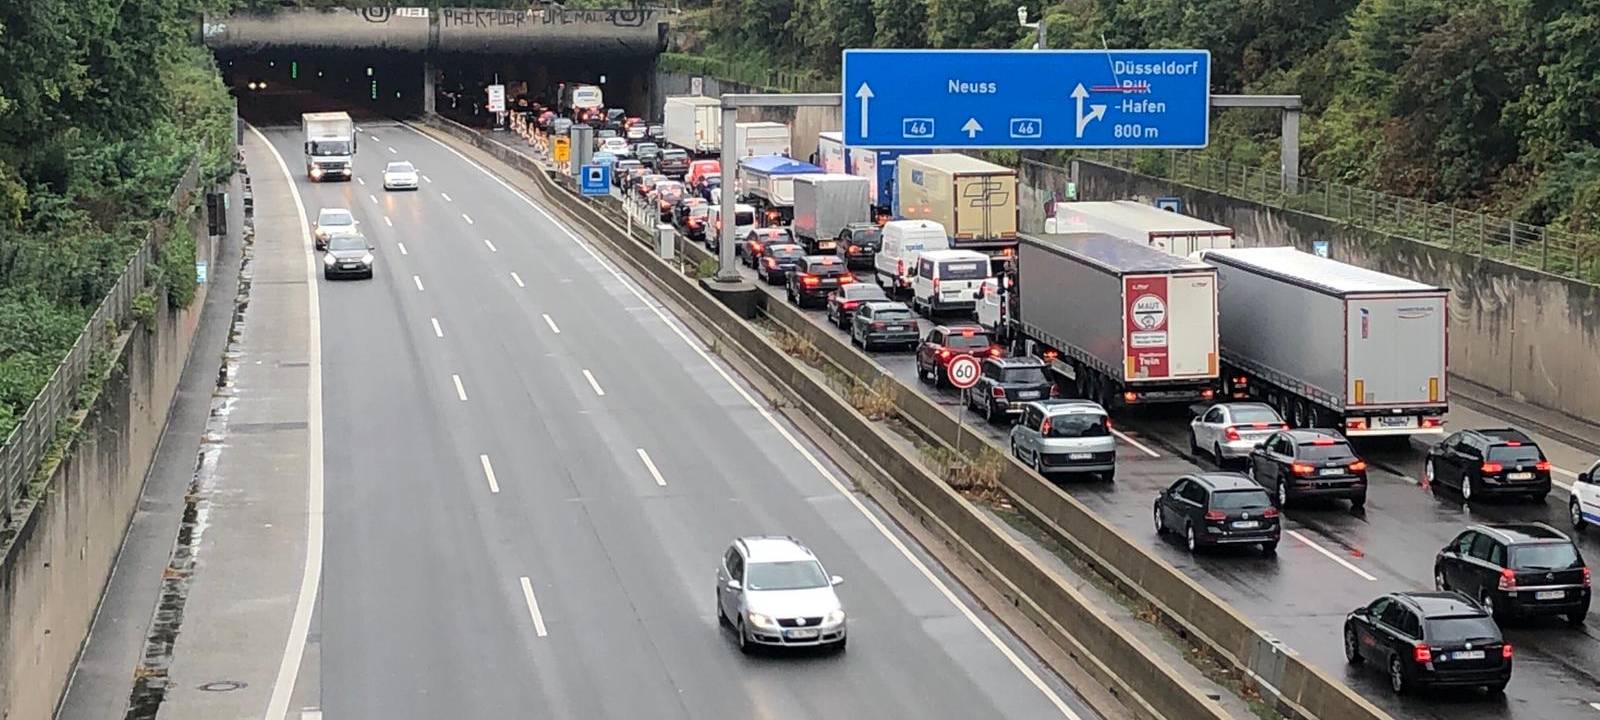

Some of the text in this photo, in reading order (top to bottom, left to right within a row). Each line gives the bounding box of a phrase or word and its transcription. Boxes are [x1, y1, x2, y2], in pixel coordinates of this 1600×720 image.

[1115, 60, 1198, 75] Düsseldorf
[948, 79, 997, 94] Neuss
[1114, 98, 1166, 113] -Hafen
[911, 122, 927, 134] 46
[1018, 122, 1034, 134] 46
[1114, 124, 1159, 139] 800 m
[1137, 302, 1160, 310] MAUT
[1139, 357, 1161, 366] Twin
[956, 364, 974, 379] 60
